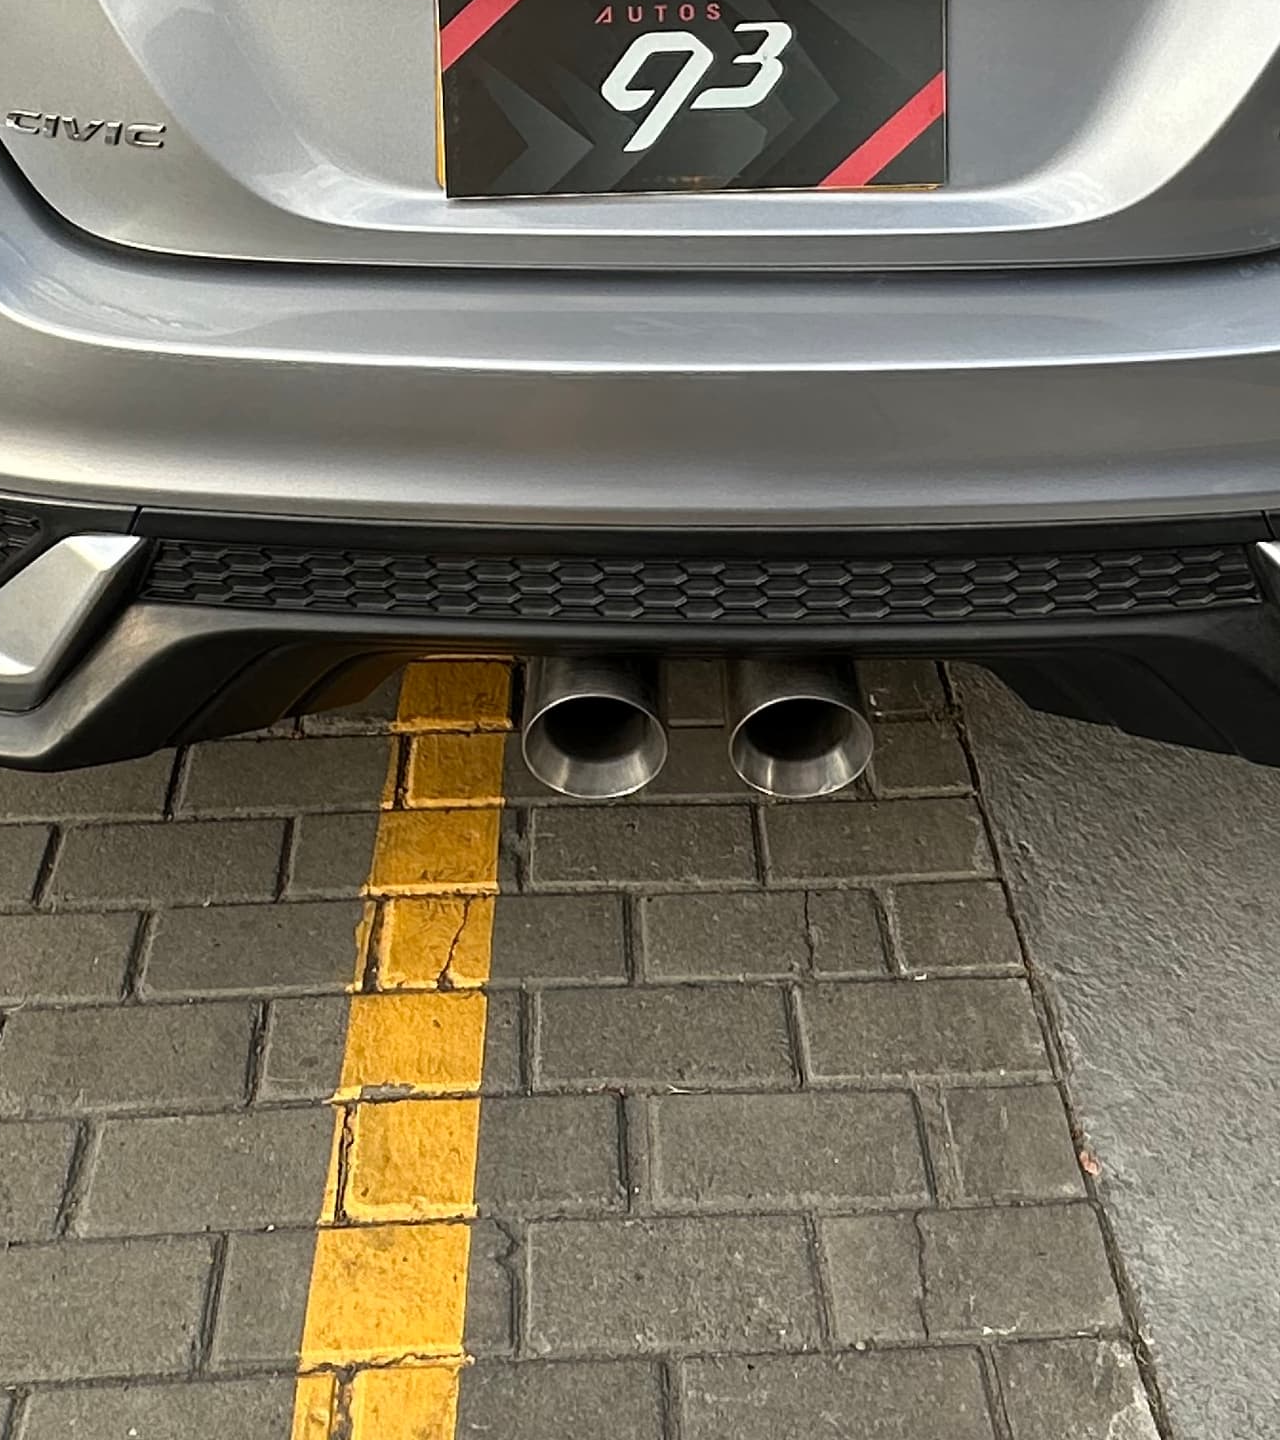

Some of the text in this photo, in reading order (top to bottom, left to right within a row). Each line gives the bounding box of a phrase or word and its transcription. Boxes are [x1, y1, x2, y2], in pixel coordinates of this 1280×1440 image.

[593, 1, 723, 25] AUTOS
[599, 20, 794, 154] 93
[5, 108, 168, 150] CIVIC
